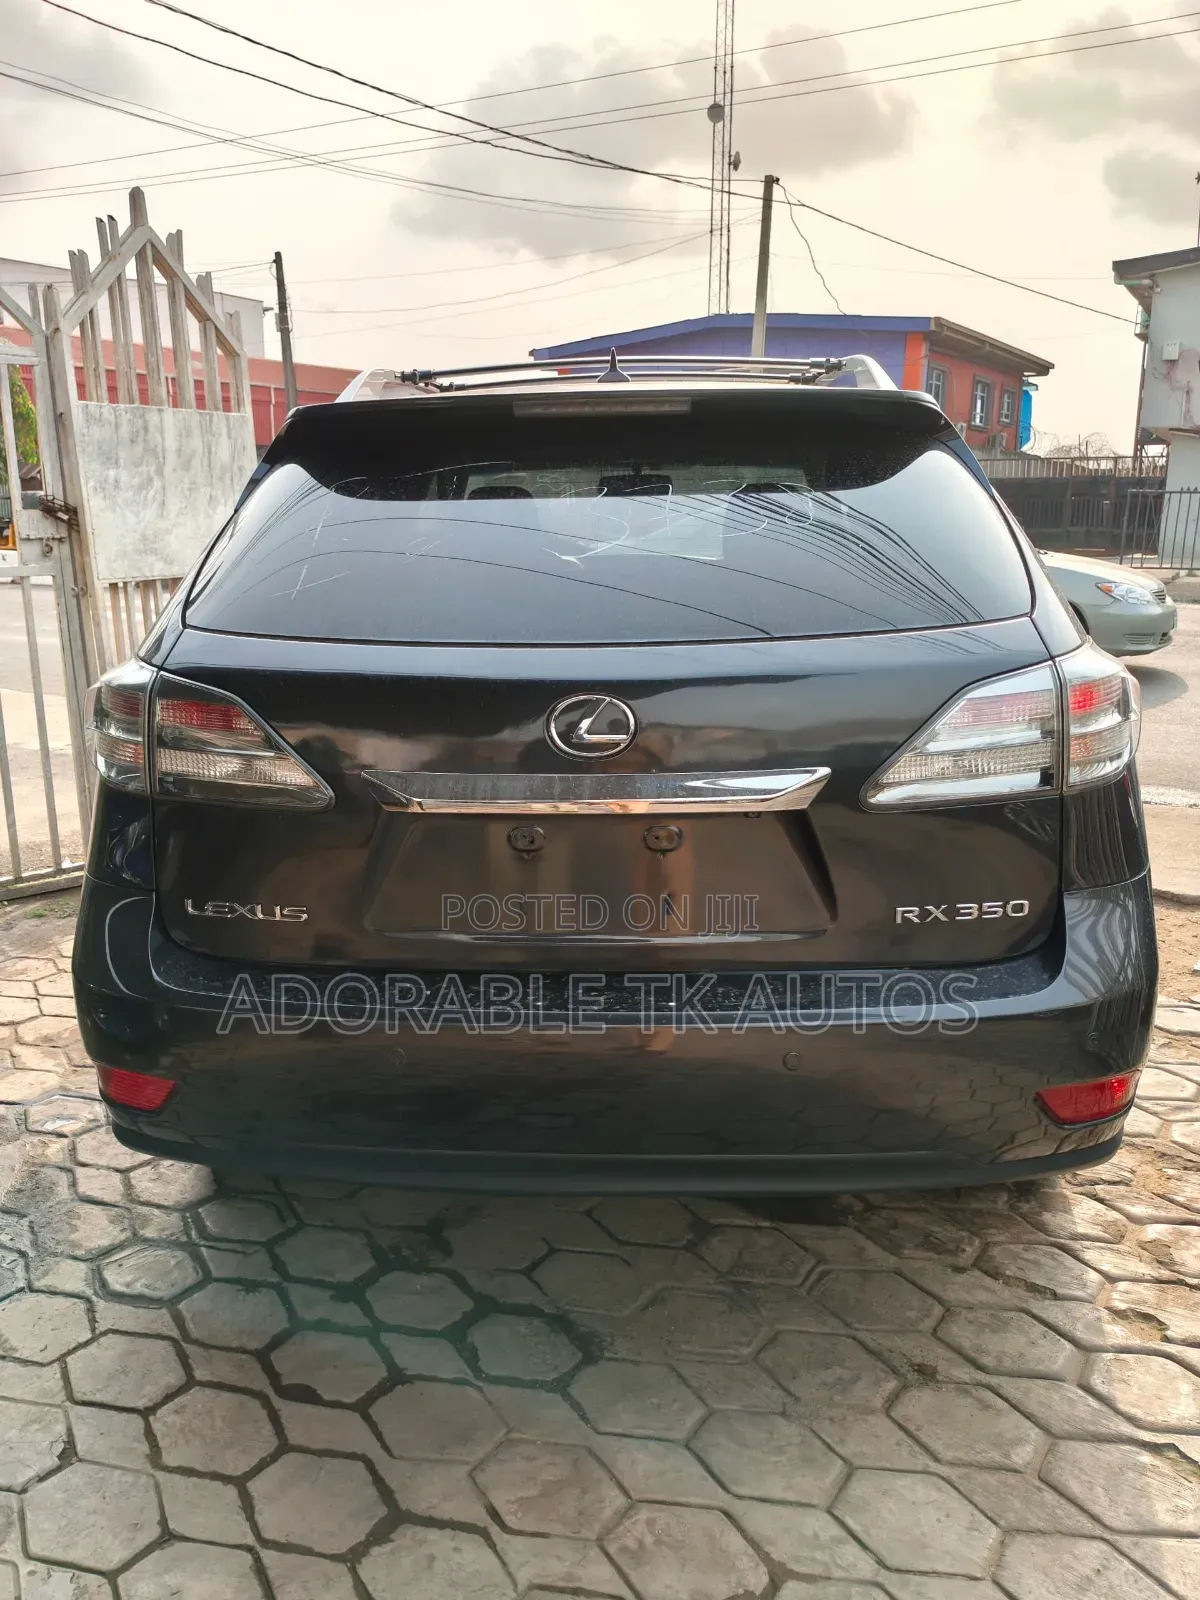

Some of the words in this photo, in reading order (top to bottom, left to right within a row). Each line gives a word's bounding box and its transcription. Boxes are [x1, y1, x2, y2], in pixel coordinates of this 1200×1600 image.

[184, 898, 309, 921] LEXUS
[895, 904, 950, 924] RX
[954, 900, 1030, 920] 350
